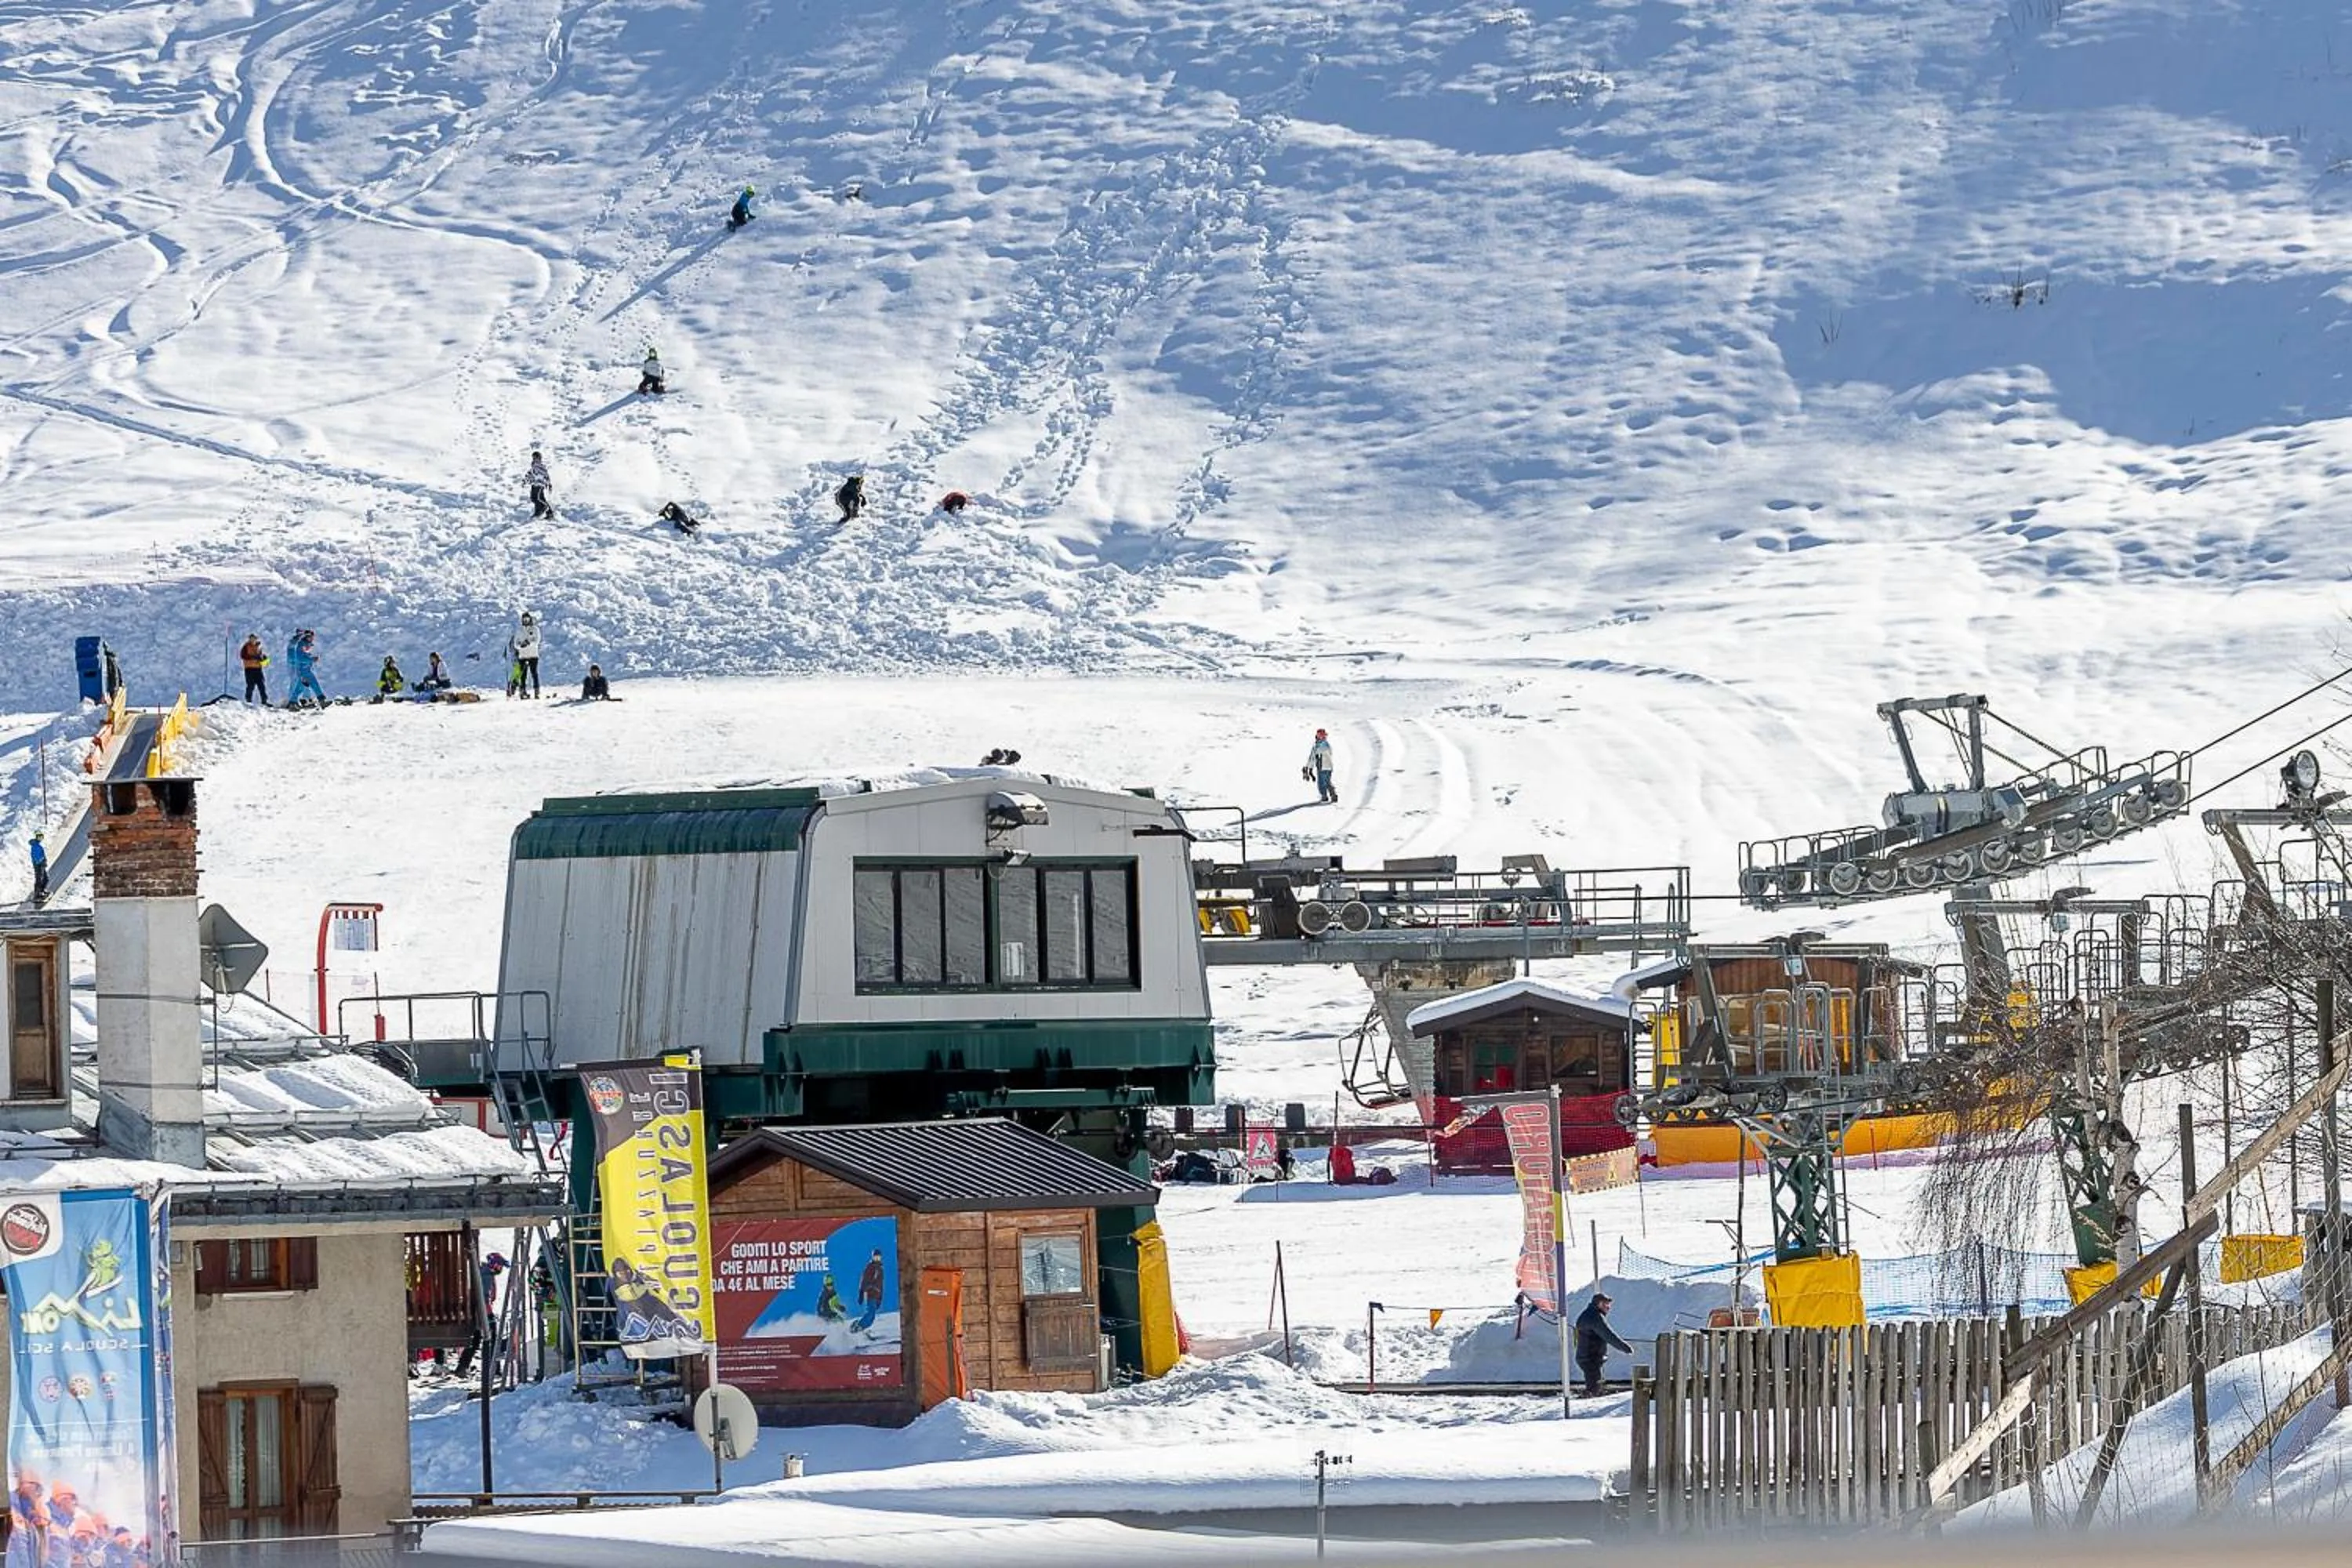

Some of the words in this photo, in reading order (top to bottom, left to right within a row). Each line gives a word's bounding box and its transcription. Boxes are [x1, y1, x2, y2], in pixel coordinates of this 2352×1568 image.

[731, 1243, 769, 1258] GODITI
[771, 1242, 786, 1256] LO
[789, 1240, 827, 1255] SPORT
[720, 1260, 743, 1275] CHE
[746, 1259, 768, 1274] AMI
[771, 1259, 779, 1273] A
[781, 1258, 829, 1272] PARTIRE
[712, 1278, 725, 1292] DA
[728, 1277, 743, 1292] 4€
[746, 1276, 760, 1291] AL
[763, 1276, 796, 1290] MESE
